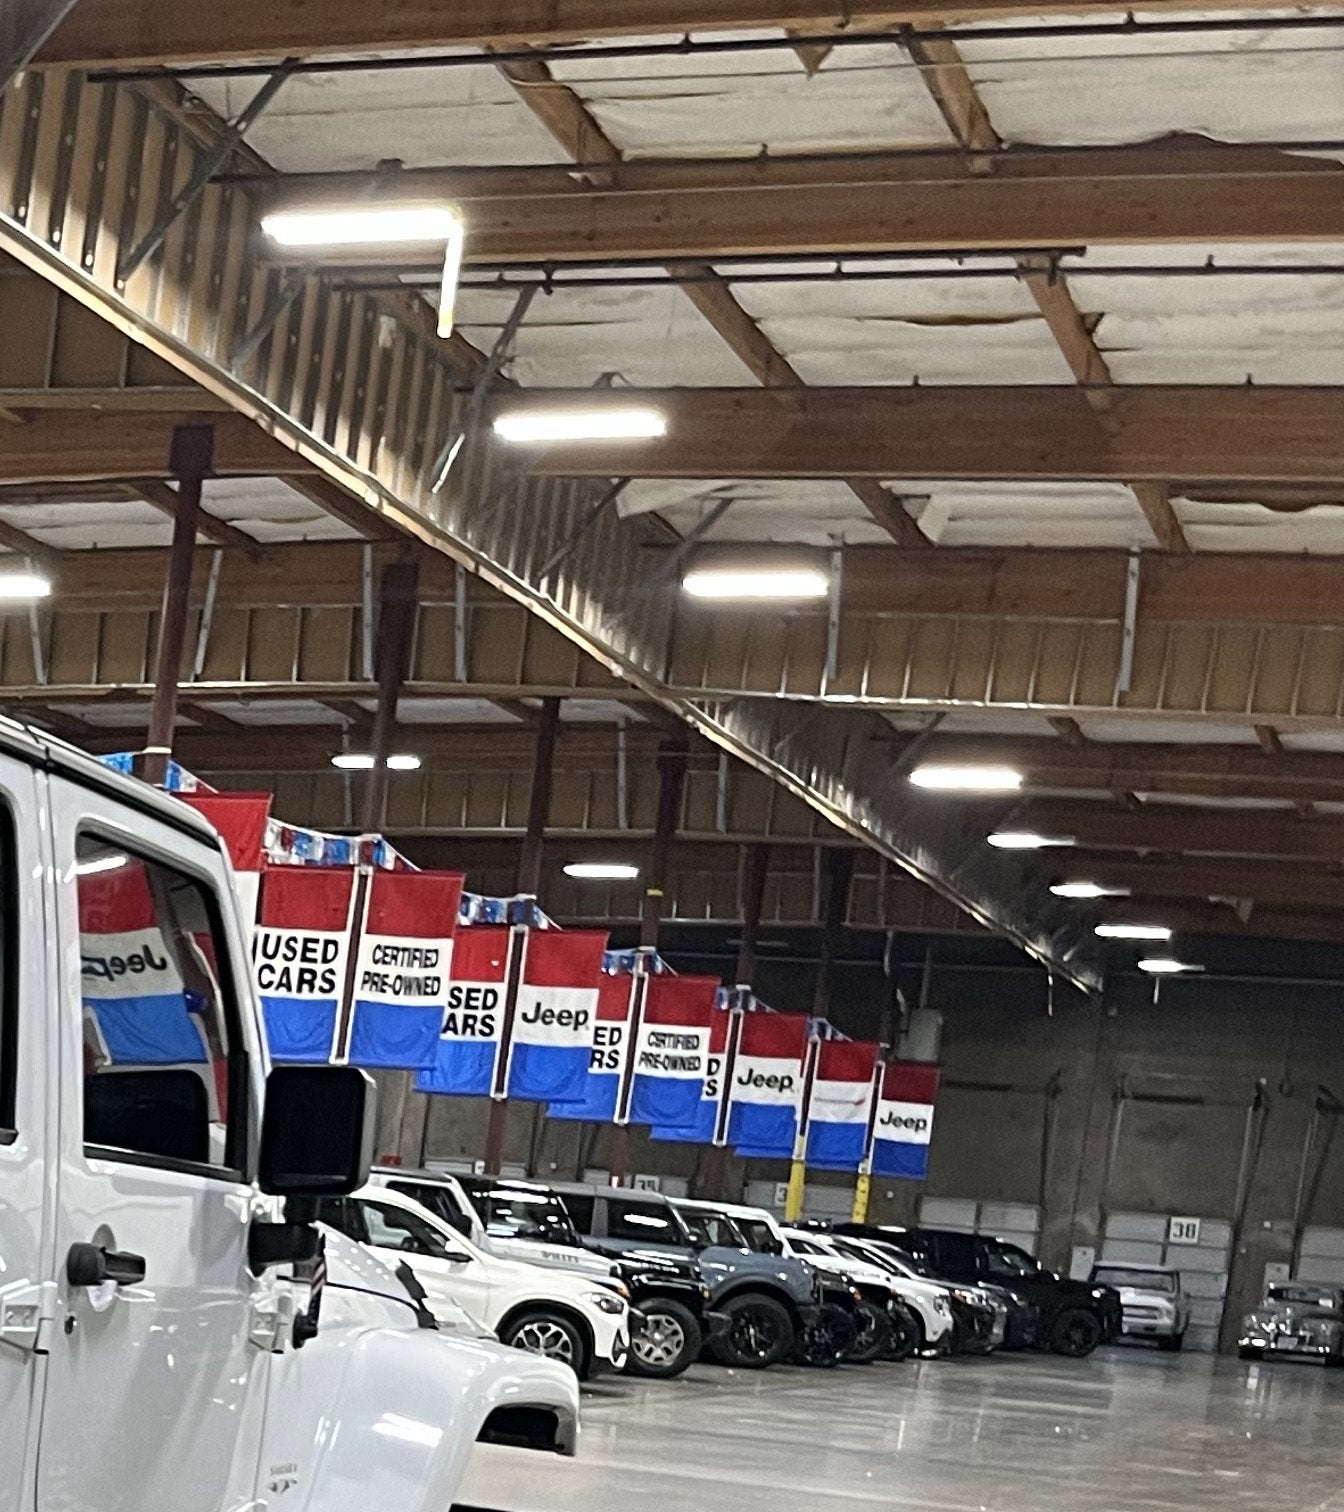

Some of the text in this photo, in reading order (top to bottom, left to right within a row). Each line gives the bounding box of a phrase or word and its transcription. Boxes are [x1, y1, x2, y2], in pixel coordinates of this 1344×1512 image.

[261, 933, 339, 964] USED
[372, 944, 439, 969] CERTIFIED
[257, 963, 336, 994] CARS
[361, 970, 442, 997] PRE-OWNED
[447, 986, 498, 1011] SED
[442, 1014, 495, 1037] ARS
[522, 1001, 589, 1031] Jeep
[594, 1026, 622, 1046] ED
[647, 1031, 700, 1049] CERTIFIED
[590, 1049, 619, 1069] RS
[737, 1068, 794, 1091] Jeep
[879, 1111, 928, 1132] Jeep
